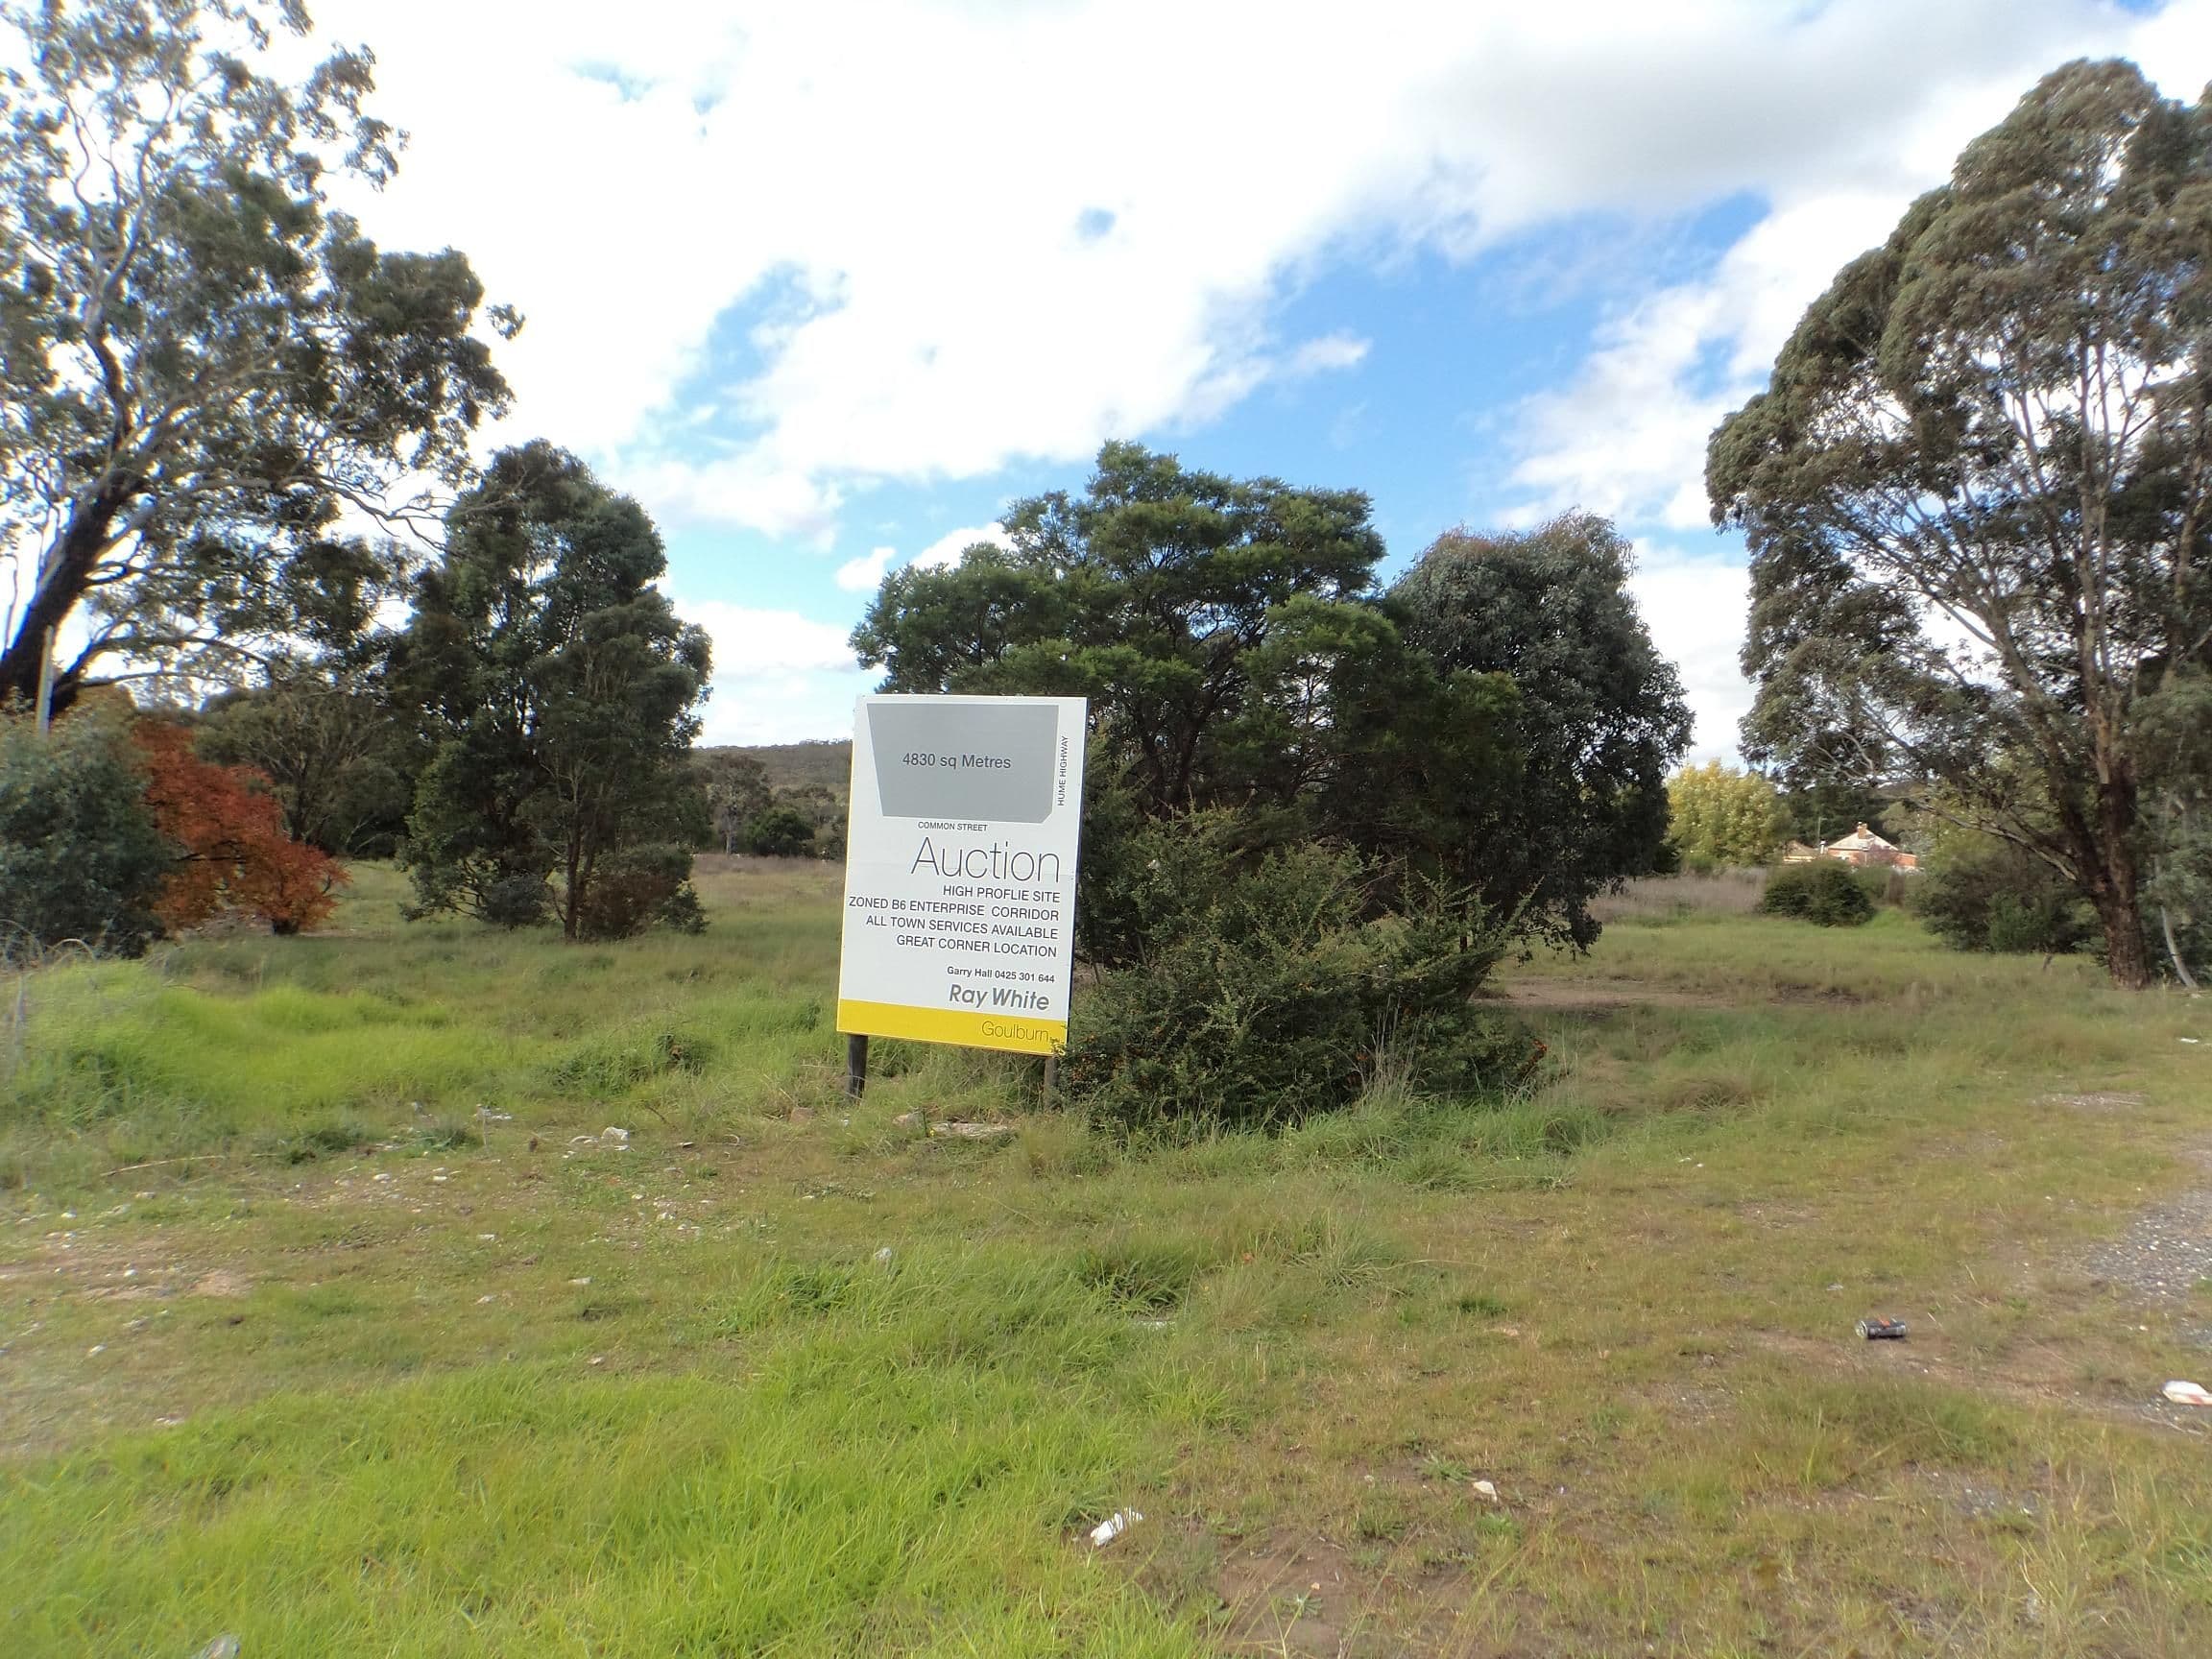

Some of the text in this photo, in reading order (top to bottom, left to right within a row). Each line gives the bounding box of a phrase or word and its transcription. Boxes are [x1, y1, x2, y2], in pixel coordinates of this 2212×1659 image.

[902, 753, 1011, 769] 4830 sq Metres
[1058, 735, 1069, 806] HUME HIGHWAY
[918, 821, 988, 831] COMMON STREET
[911, 836, 1060, 882] Auction
[943, 885, 1060, 903] HIGH PROFLIE SITE
[849, 897, 1059, 921] ZONED B6 ENTERPRISE CORRIDOR
[866, 915, 1058, 939] ALL TOWN SERVICES AVAILABLE
[897, 935, 1057, 957] GREAT CORNER LOCATION
[947, 966, 1055, 983] Garry Hall 0425 301 644
[949, 984, 1049, 1010] Ray White
[981, 1021, 1049, 1041] Goulburn
